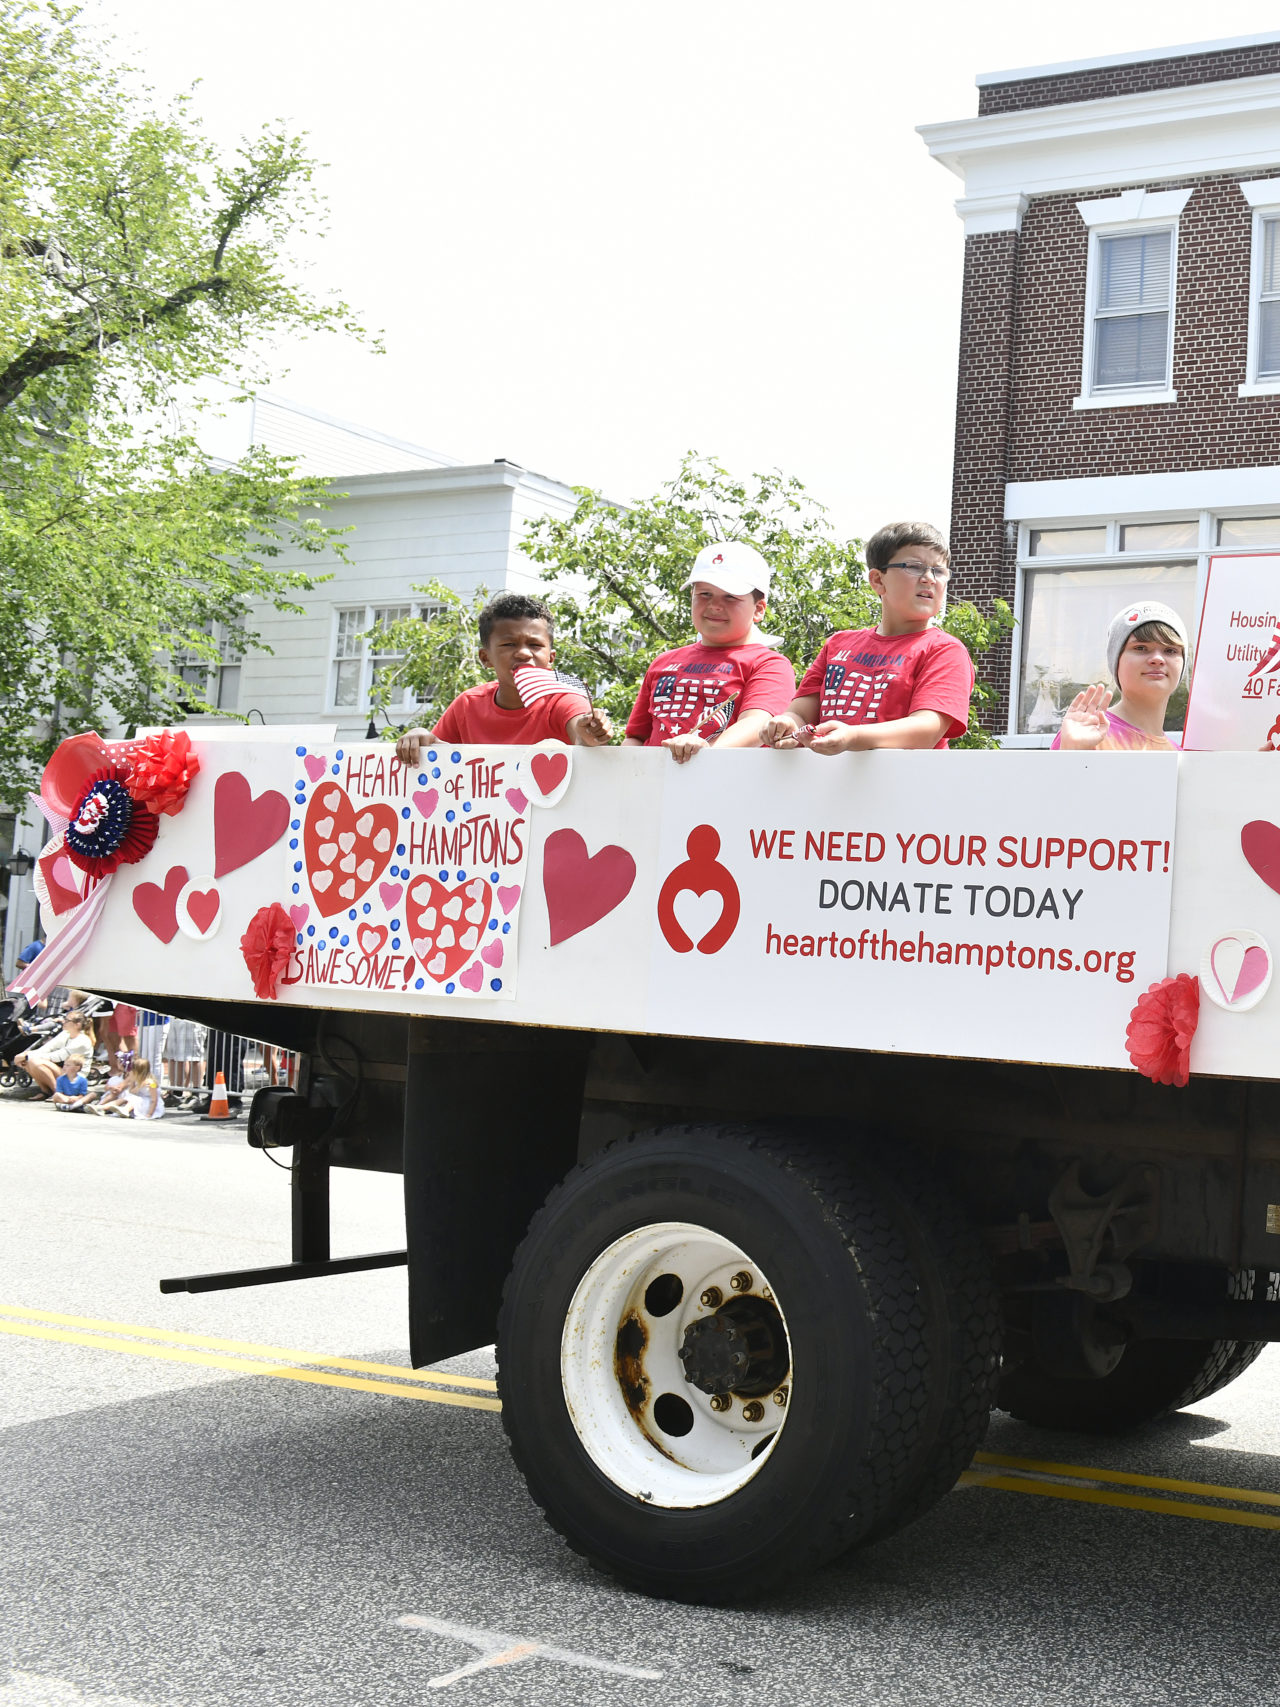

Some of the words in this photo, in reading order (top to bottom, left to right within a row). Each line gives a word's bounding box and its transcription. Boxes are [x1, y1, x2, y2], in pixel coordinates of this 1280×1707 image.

[1230, 611, 1277, 628] Housin
[1242, 678, 1264, 698] 40
[444, 774, 464, 800] of
[465, 757, 505, 799] THE
[410, 814, 526, 868] HAMPTONS
[750, 829, 796, 860] WE
[804, 830, 886, 863] NEED
[896, 832, 987, 867] YOUR
[997, 836, 1171, 873] SUPPORT!
[818, 879, 953, 915] DONATE
[963, 884, 1084, 921] TODAY
[765, 923, 1136, 984] heartofthehamptons.org
